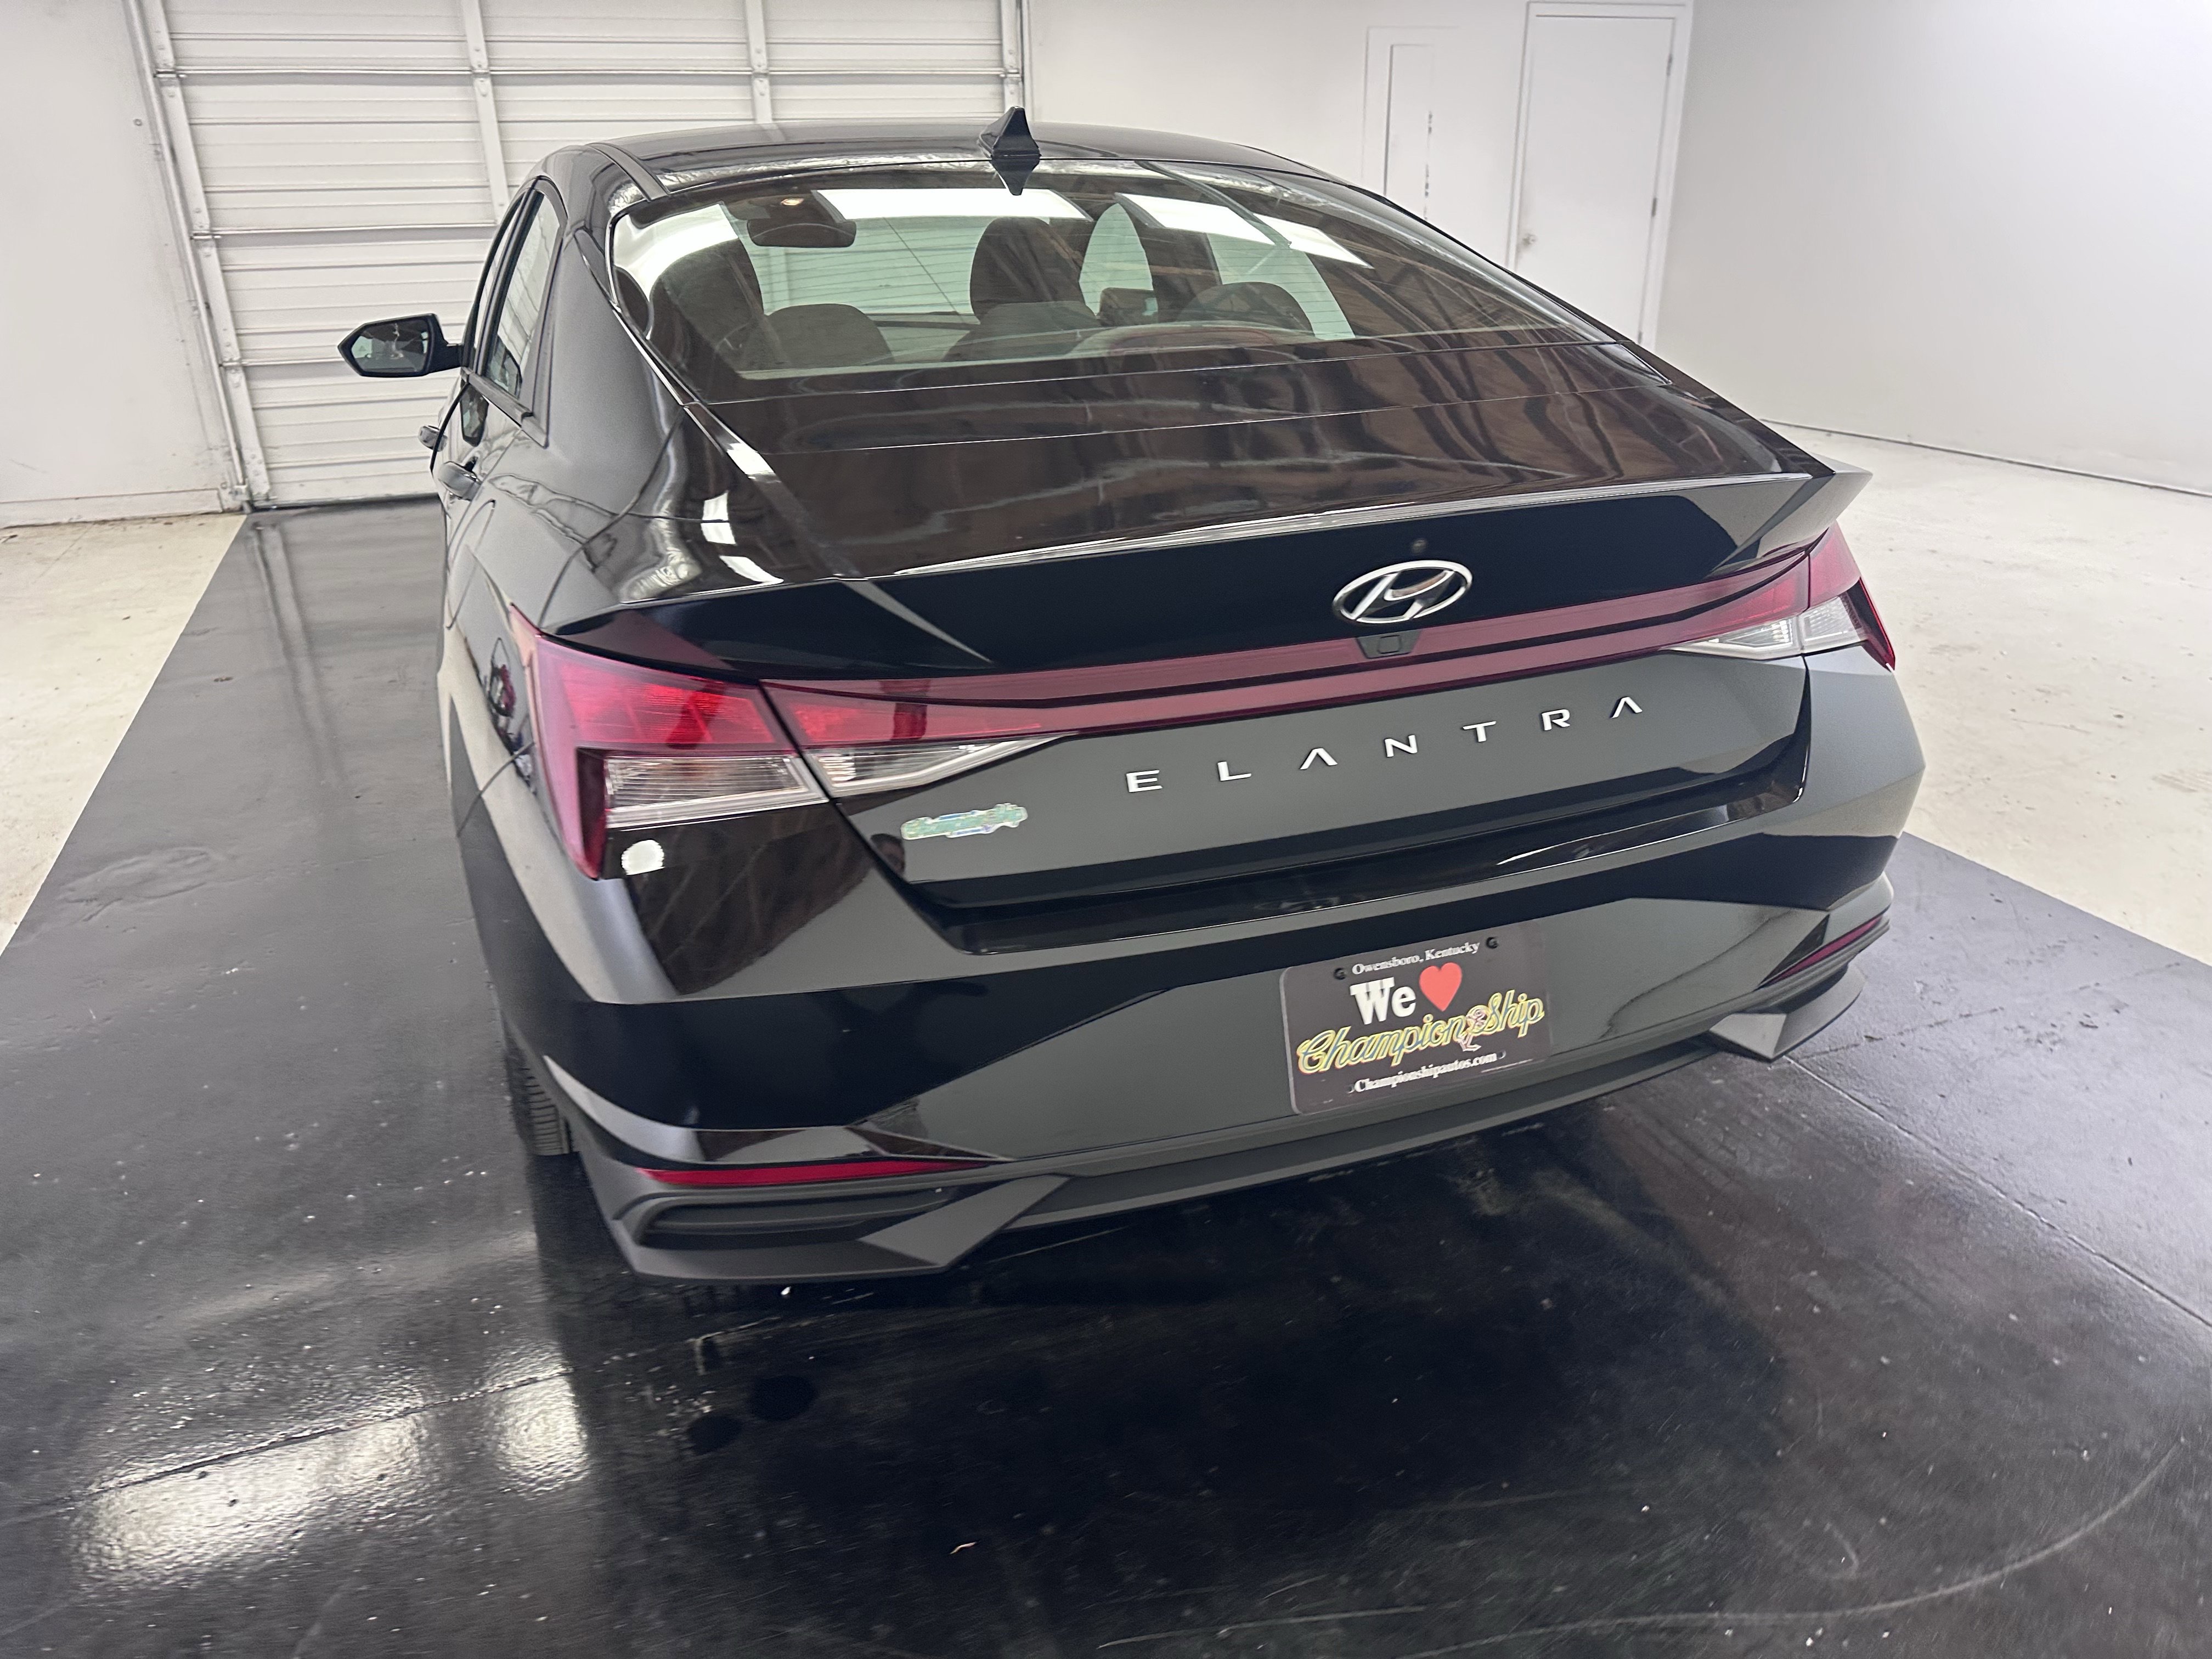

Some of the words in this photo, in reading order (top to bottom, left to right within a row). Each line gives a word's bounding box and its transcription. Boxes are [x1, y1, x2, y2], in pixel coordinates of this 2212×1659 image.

[1125, 696, 1643, 793] ELANTRA
[1351, 954, 1424, 975] Owensboro,
[1425, 940, 1481, 961] Kentucky
[1349, 976, 1417, 1025] We
[1354, 1052, 1497, 1092] Championshipautos.com
